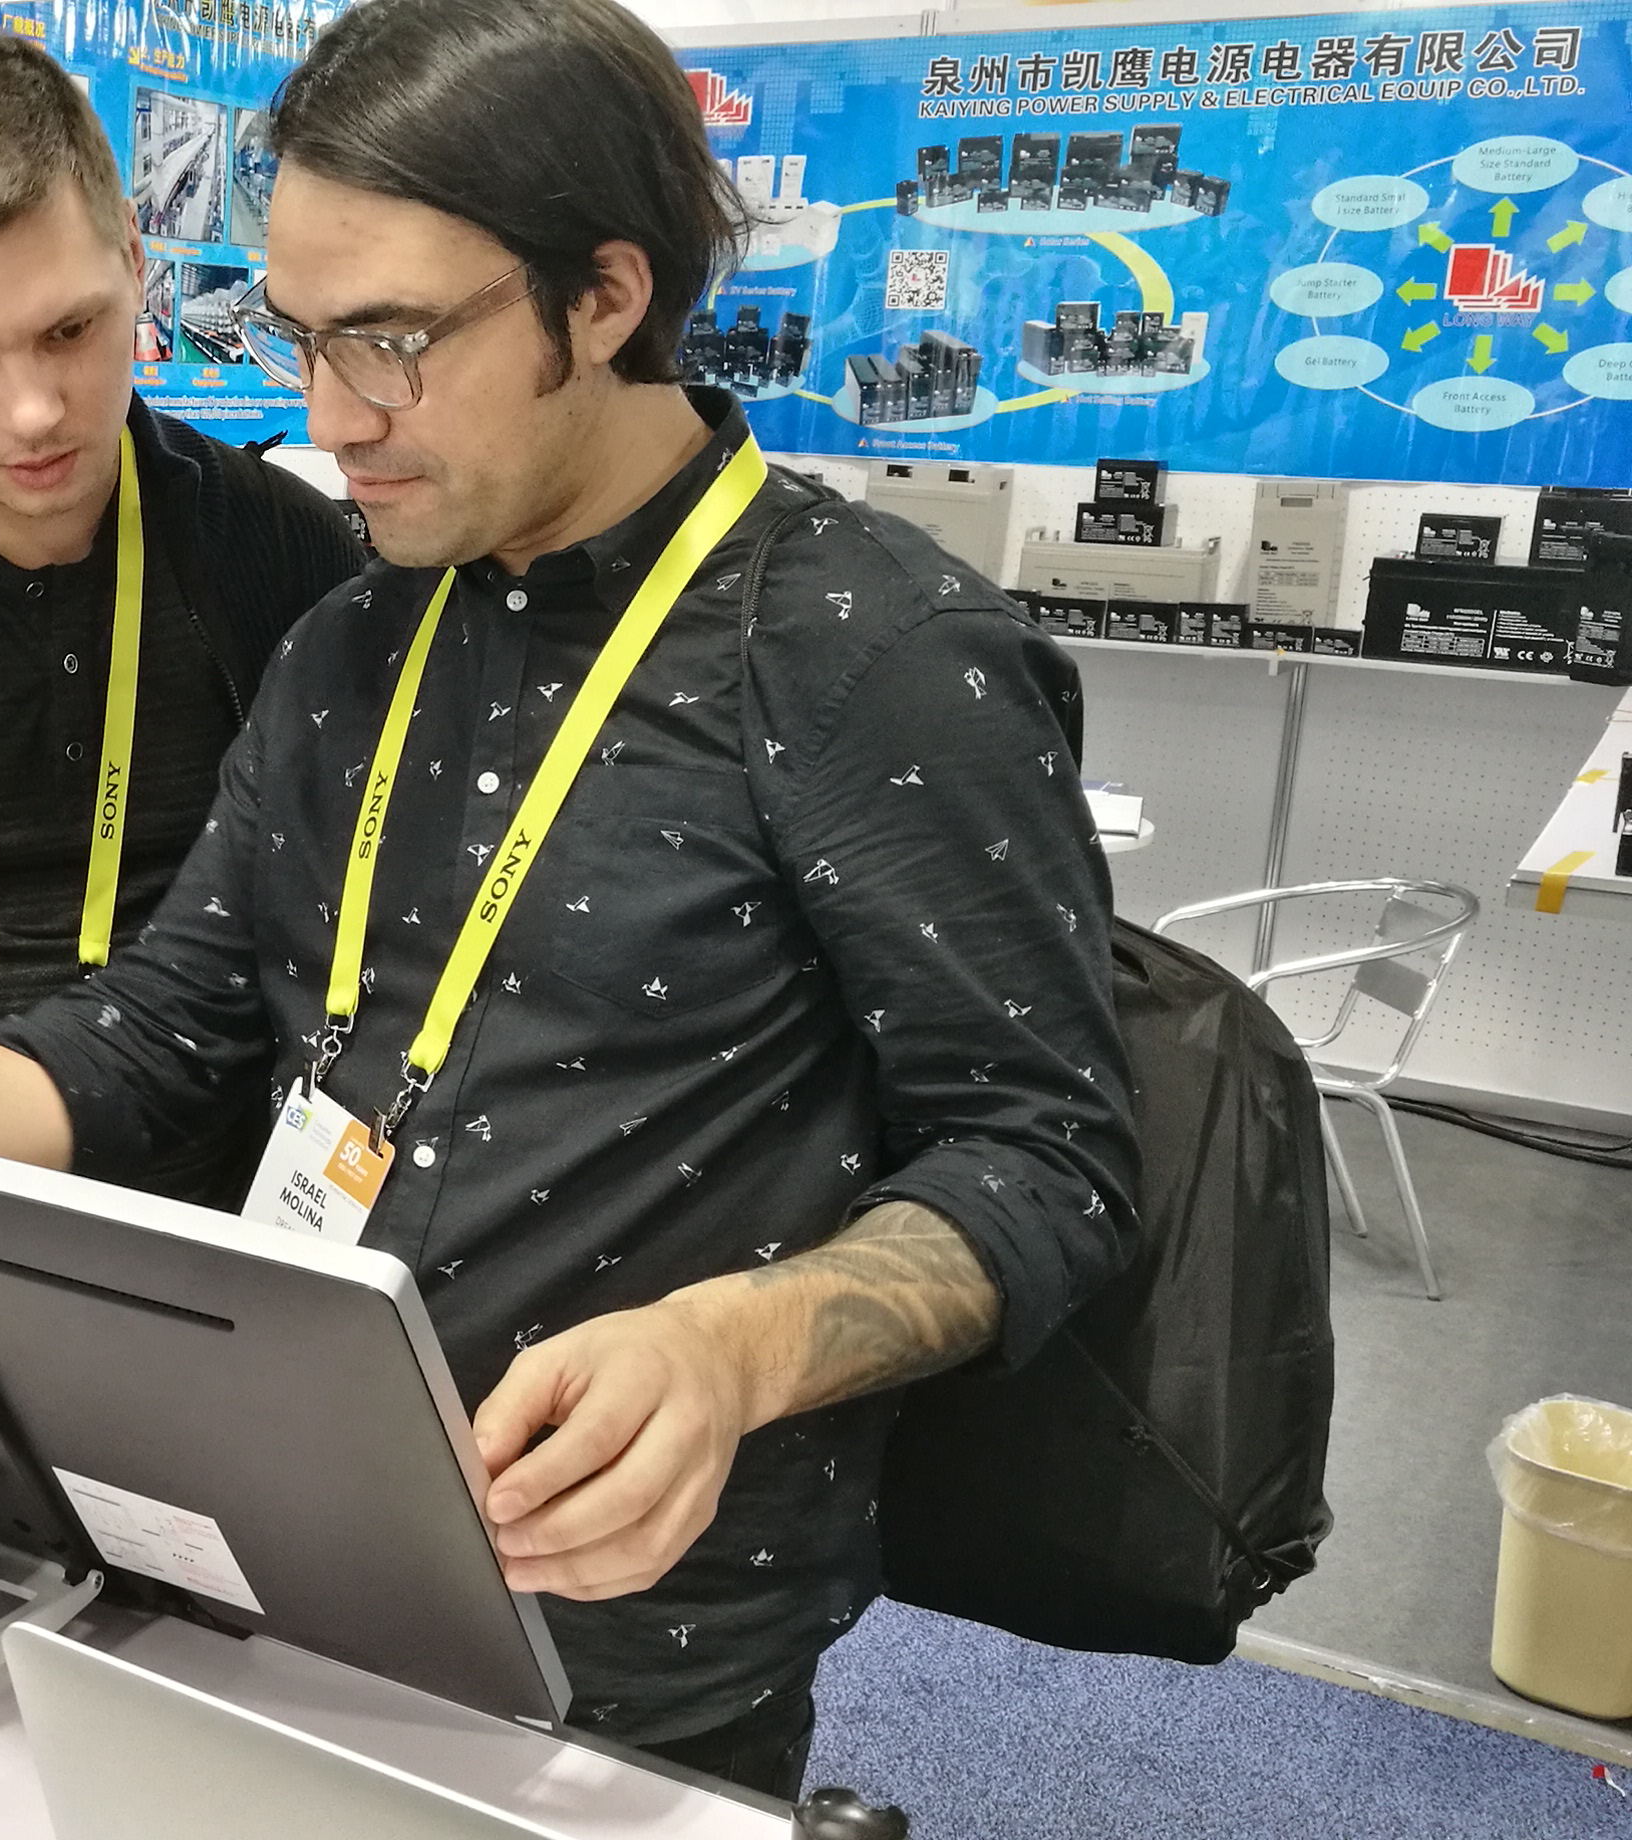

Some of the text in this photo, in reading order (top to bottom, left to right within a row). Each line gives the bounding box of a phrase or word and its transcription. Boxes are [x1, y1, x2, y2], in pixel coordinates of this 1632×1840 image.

[923, 27, 1582, 96] 泉州市凯鹰电源电器有限公司
[919, 76, 1585, 118] KAIYING POWER SUPPLY & ELECTRICAL EQUIP CO.,LTD.
[1479, 147, 1556, 156] Medium-Large
[1480, 159, 1551, 169] Size Standard
[1494, 173, 1533, 182] Battery
[1335, 194, 1379, 203] Standard
[1364, 206, 1400, 216] Battery
[1324, 279, 1357, 288] Starter
[1307, 291, 1341, 300] Battery
[1443, 312, 1536, 328] LONG WAY
[1304, 357, 1357, 368] Gel Battery
[1598, 359, 1626, 369] Deep
[1442, 391, 1507, 402] Front Access
[1454, 405, 1491, 416] Battery
[100, 760, 121, 840] SONY
[358, 770, 389, 859] SONY
[479, 828, 532, 924] SONY
[287, 1107, 307, 1130] CES
[339, 1141, 362, 1167] 50
[290, 1169, 327, 1210] ISRAEL
[279, 1186, 324, 1233] MOLINA
